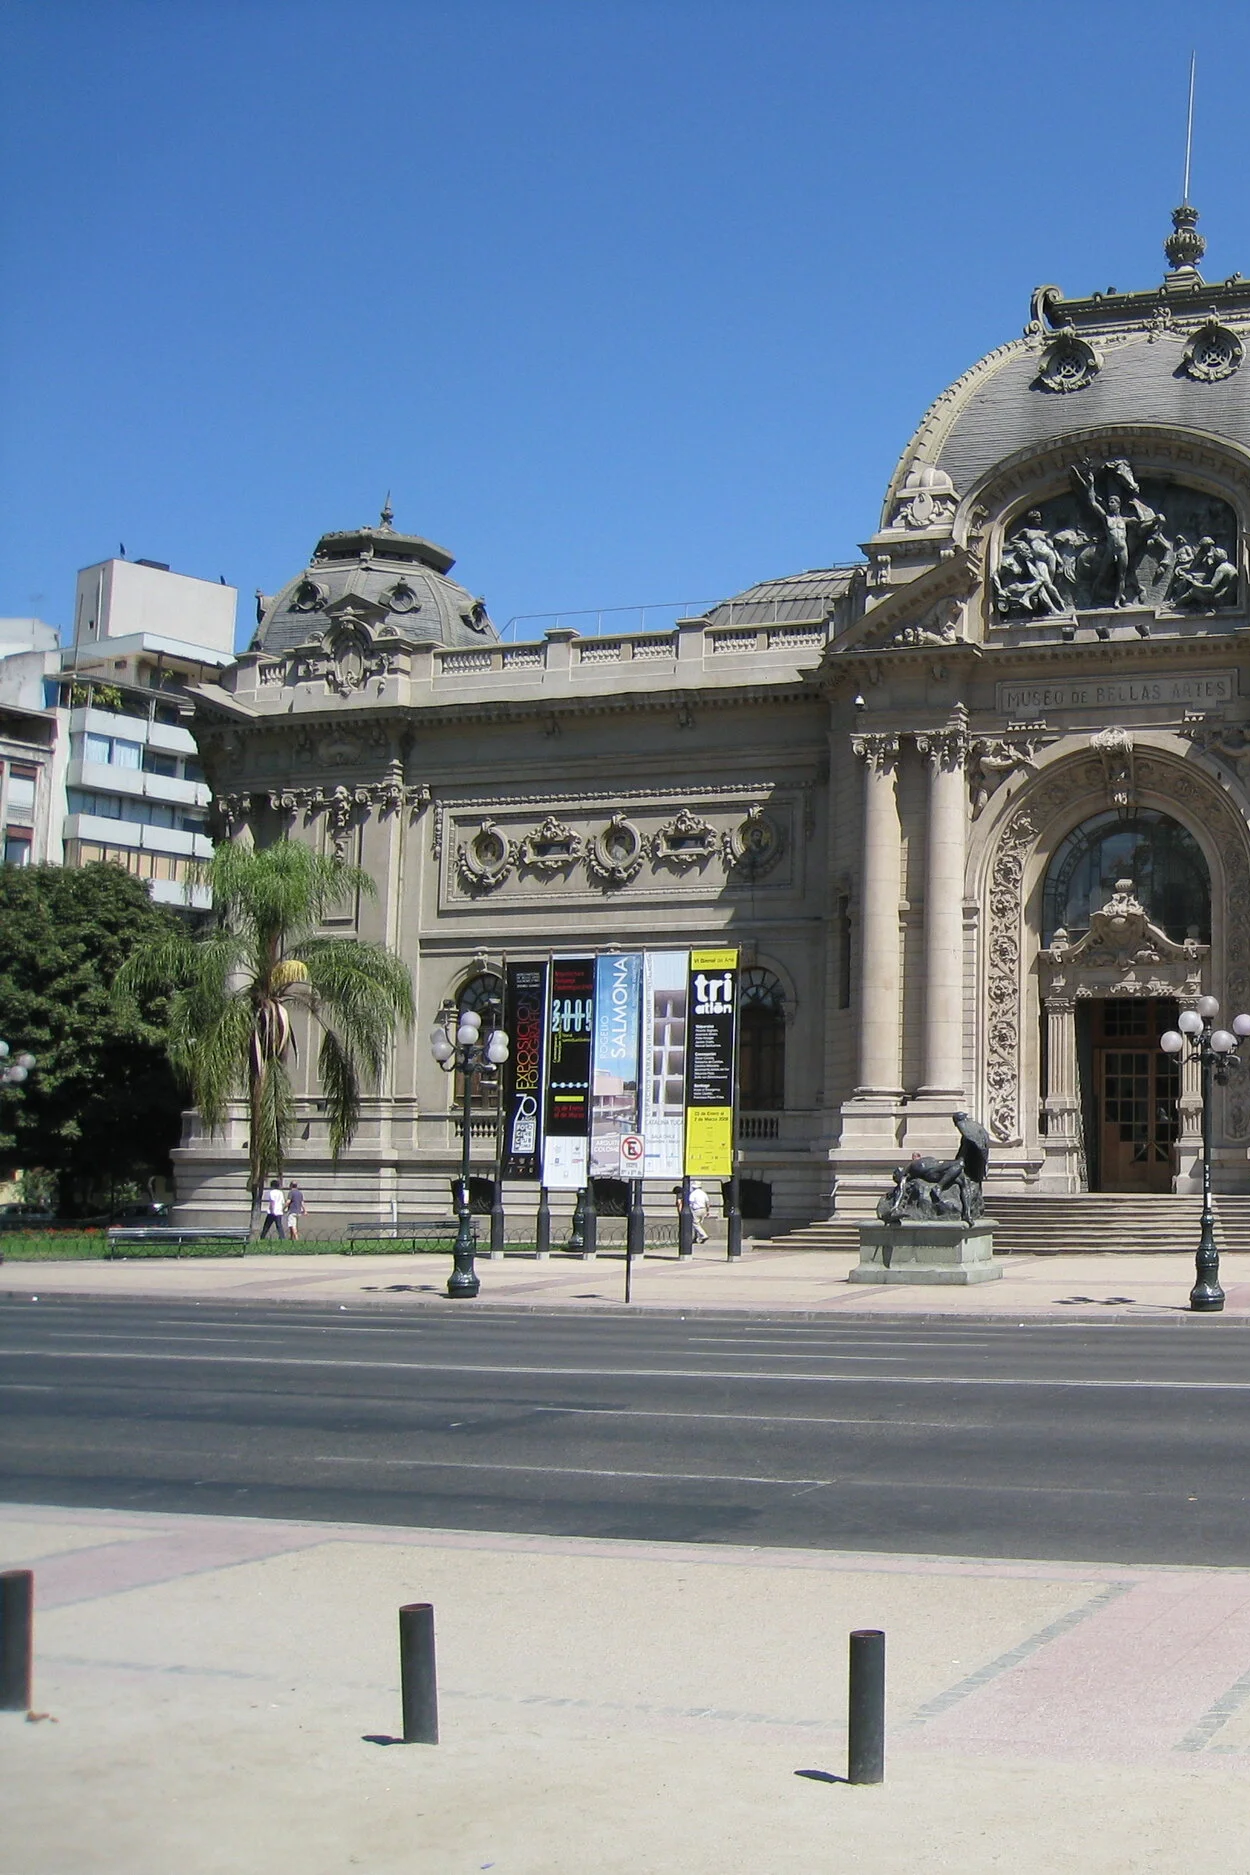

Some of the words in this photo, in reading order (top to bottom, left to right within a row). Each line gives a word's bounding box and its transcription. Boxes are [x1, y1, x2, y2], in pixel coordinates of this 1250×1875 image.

[1007, 691, 1065, 708] MUSEO
[1071, 690, 1088, 704] DE
[1096, 684, 1161, 702] BELLAS
[1171, 680, 1226, 699] ARTES
[694, 972, 732, 1002] tri
[610, 955, 628, 1058] SALMONA
[599, 1015, 609, 1059] ROGELIO
